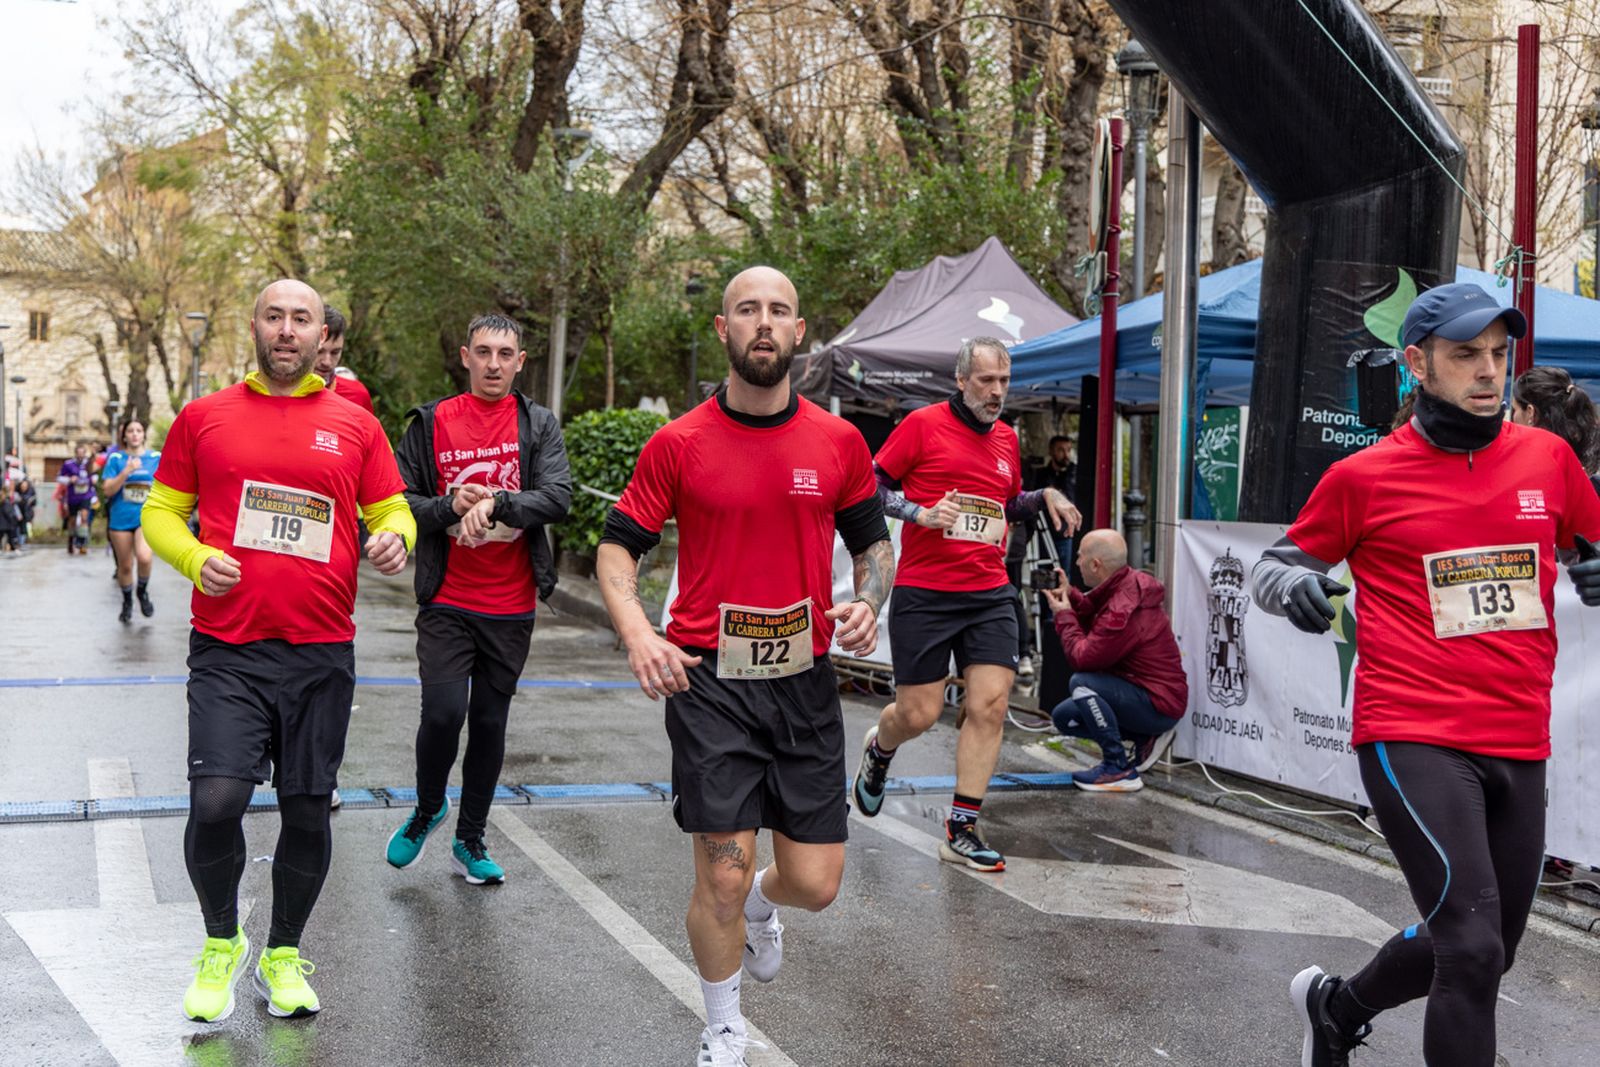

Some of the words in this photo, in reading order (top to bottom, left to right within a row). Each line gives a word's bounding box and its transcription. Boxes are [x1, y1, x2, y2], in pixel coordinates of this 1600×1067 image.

[439, 450, 453, 463] IES
[454, 449, 474, 460] San
[476, 446, 500, 458] Juan
[252, 487, 265, 497] IES
[267, 490, 282, 500] San
[284, 492, 304, 504] Juan
[306, 497, 327, 510] Bosco
[248, 498, 256, 507] V
[256, 499, 292, 513] CARRERA
[295, 505, 328, 522] POPULAR
[271, 515, 303, 542] 119
[965, 515, 988, 533] 137
[1437, 559, 1454, 571] IES
[1456, 557, 1476, 568] San
[1501, 552, 1530, 563] Bosco
[1436, 574, 1444, 584] V
[1447, 568, 1494, 583] CARRERA
[1494, 565, 1534, 578] POPULAR
[1468, 583, 1515, 616] 133
[728, 623, 734, 634] V
[736, 624, 774, 637] CARRERA
[777, 618, 807, 636] POPULAR
[731, 612, 744, 622] IES
[746, 614, 762, 624] San
[764, 616, 785, 625] Juan
[786, 609, 804, 622] Bosco
[750, 640, 790, 666] 122
[1192, 711, 1223, 732] CIUDAD
[1224, 718, 1237, 736] DE
[1238, 720, 1264, 742] JAÉN
[1293, 707, 1335, 730] Patronato
[1304, 730, 1344, 752] Deportes
